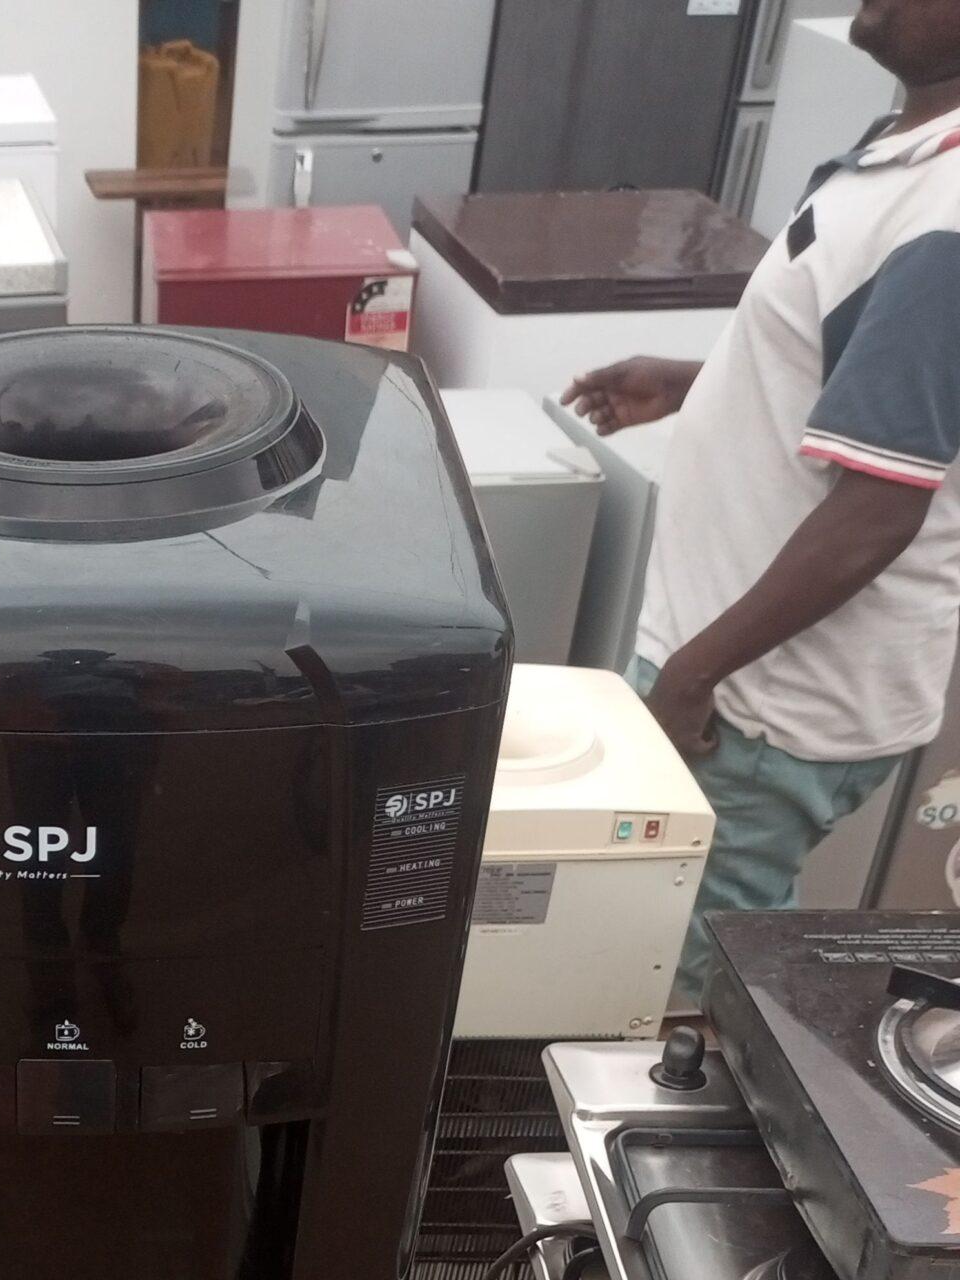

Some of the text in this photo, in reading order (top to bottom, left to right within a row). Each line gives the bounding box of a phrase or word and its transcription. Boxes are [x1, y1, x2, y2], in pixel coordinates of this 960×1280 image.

[414, 788, 456, 811] SPJ
[405, 821, 446, 835] COOLING
[3, 825, 97, 863] SPJ
[399, 858, 441, 872] HEATING
[17, 870, 67, 880] Matters
[394, 896, 424, 908] POWER
[47, 1042, 90, 1050] NORMAL
[180, 1040, 208, 1049] COLD
